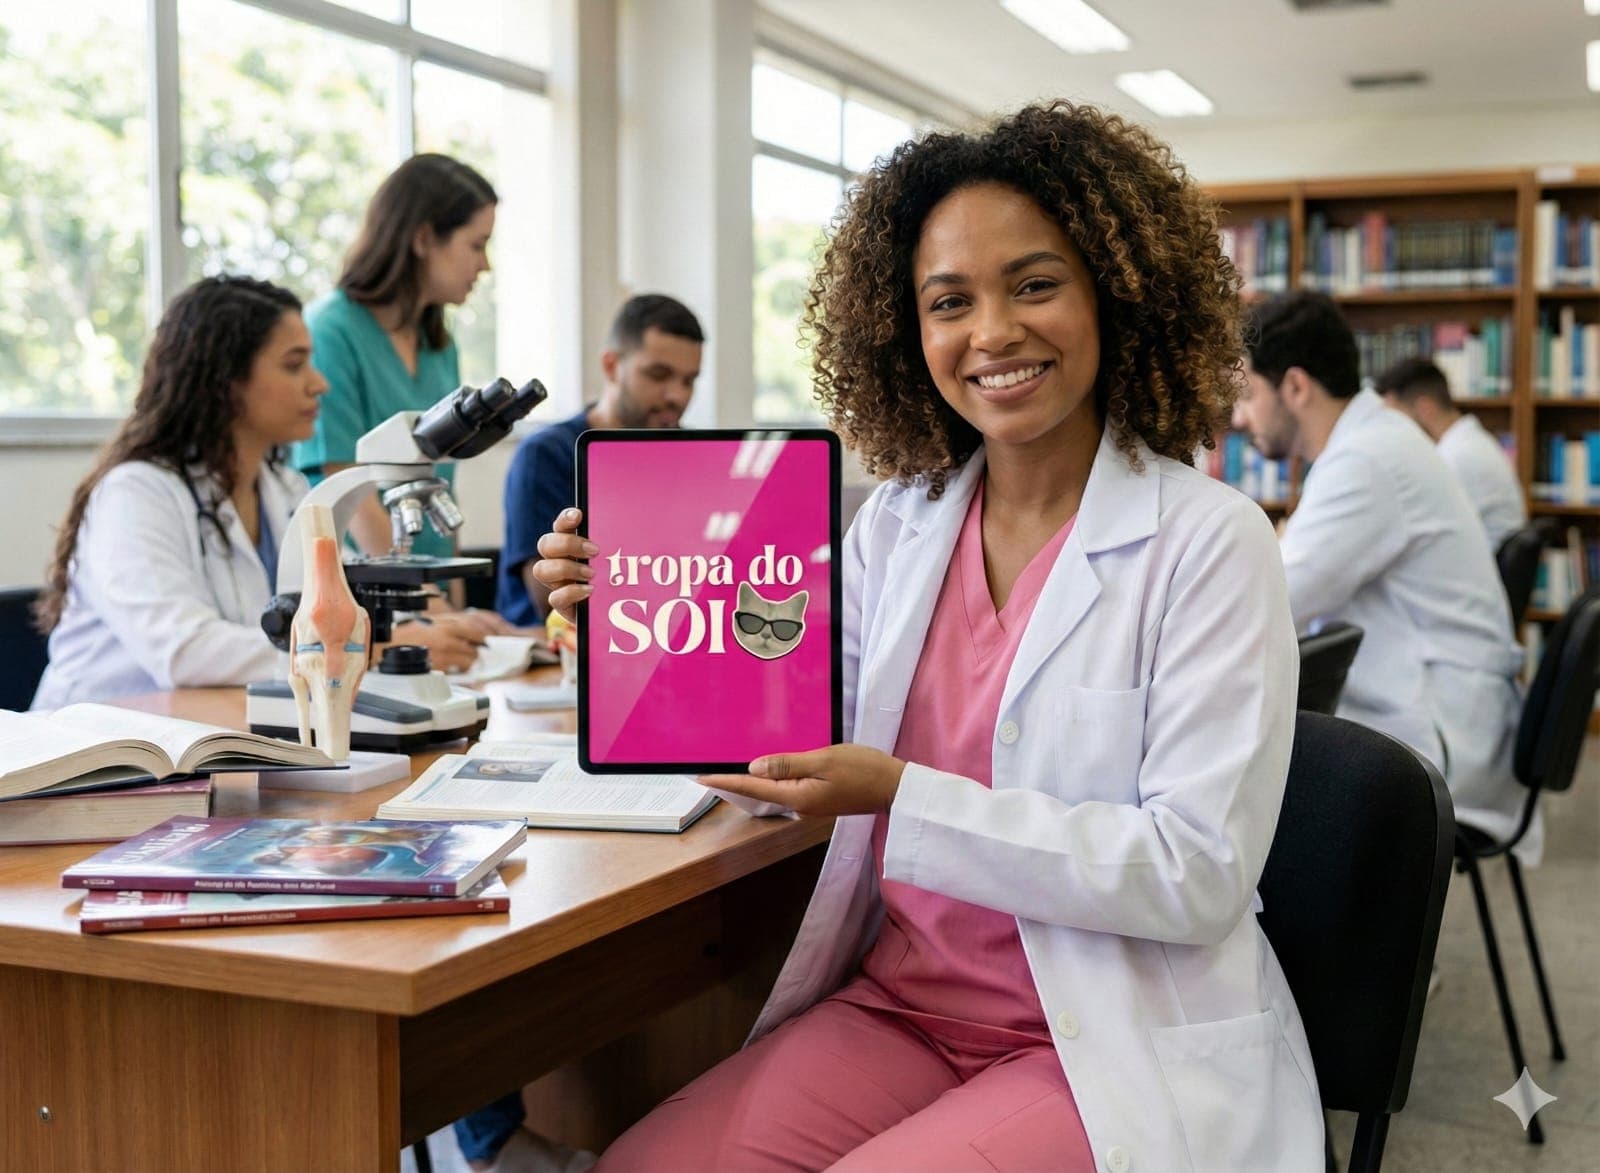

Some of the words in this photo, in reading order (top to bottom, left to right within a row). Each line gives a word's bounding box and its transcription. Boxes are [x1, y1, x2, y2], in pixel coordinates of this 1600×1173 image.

[606, 548, 734, 597] tropa
[749, 545, 803, 585] do
[608, 598, 726, 655] SOI
